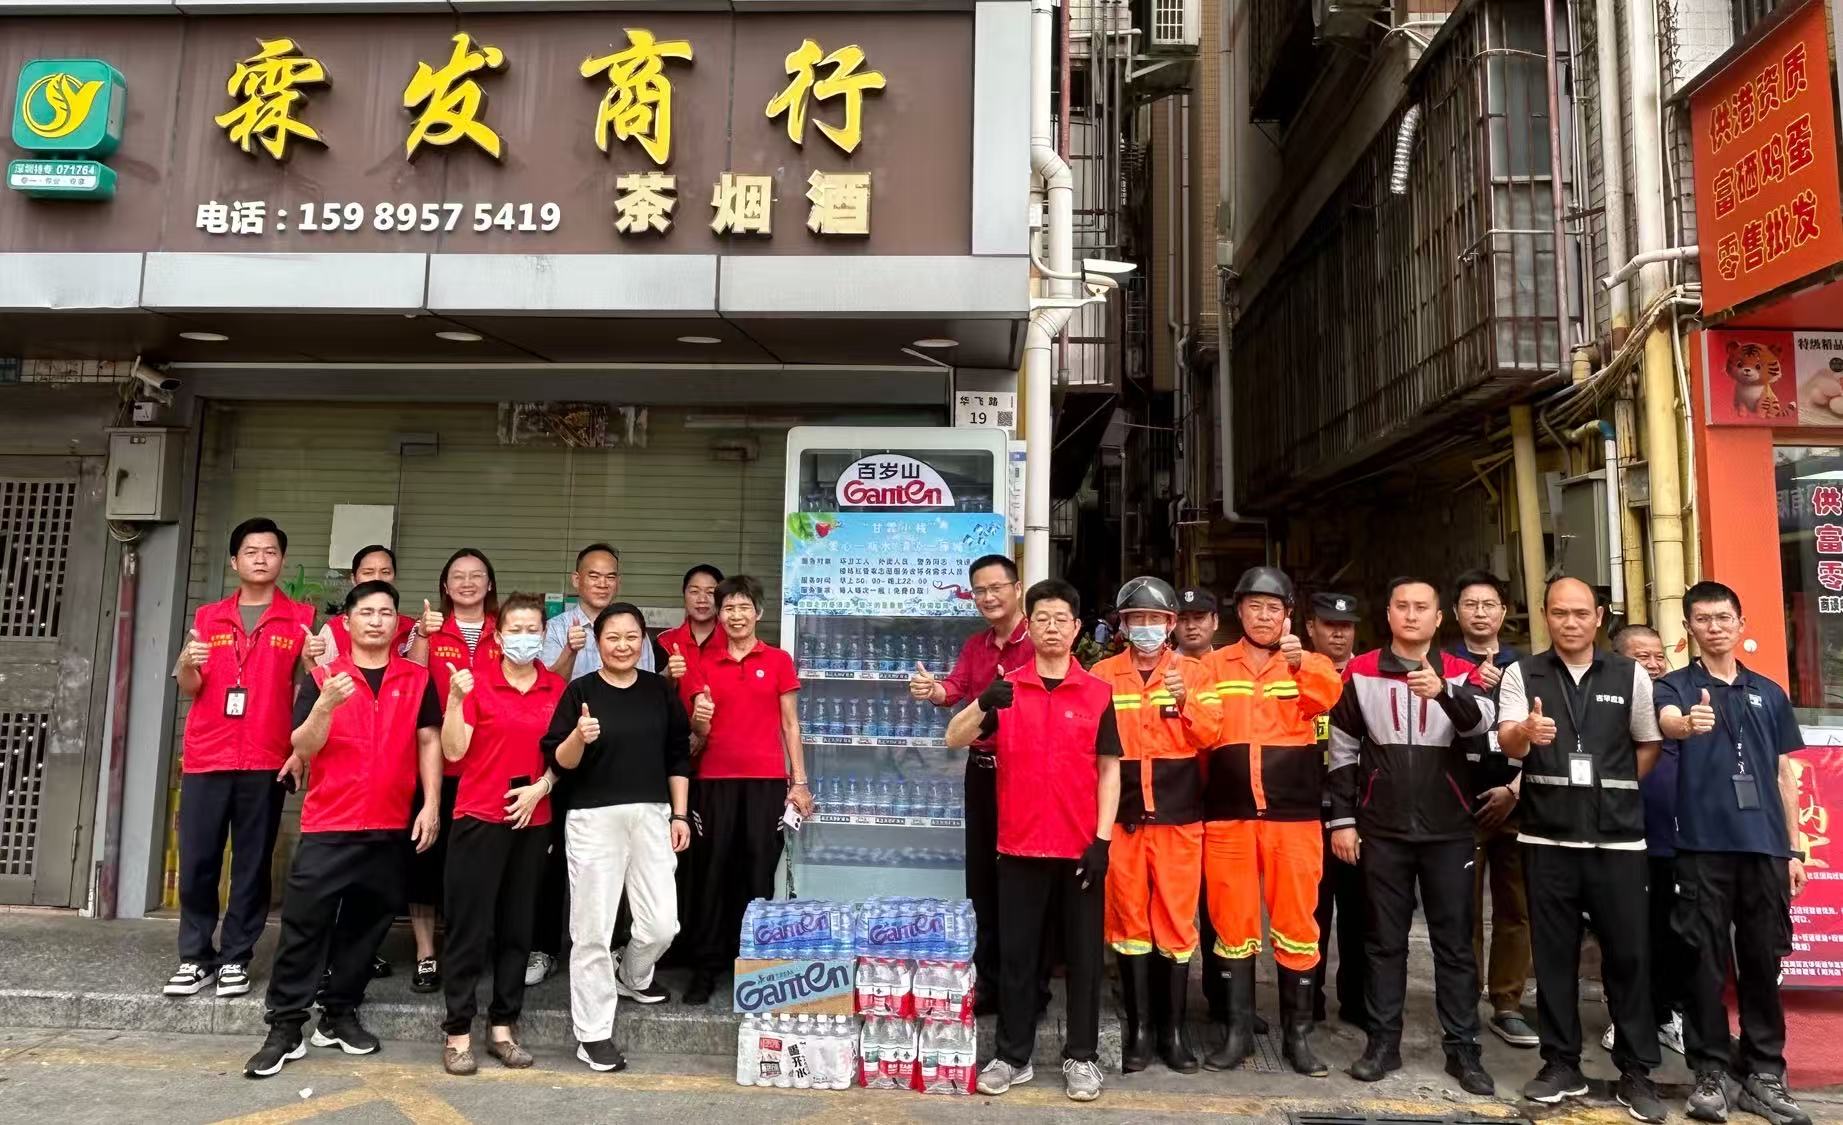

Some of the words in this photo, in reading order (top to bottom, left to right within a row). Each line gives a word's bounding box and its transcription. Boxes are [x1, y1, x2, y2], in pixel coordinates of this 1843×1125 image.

[213, 28, 887, 166] 霖发商行
[1709, 41, 1807, 154] 供港资质
[56, 164, 95, 175] 071764
[1713, 113, 1813, 220] 富硒鸡蛋
[298, 202, 364, 232] 159
[373, 203, 463, 232] 8957
[472, 202, 562, 233] 5419
[614, 169, 872, 237] 茶烟酒
[1717, 189, 1820, 280] 零售批发
[969, 411, 987, 425] 19
[857, 463, 920, 479] 百岁山
